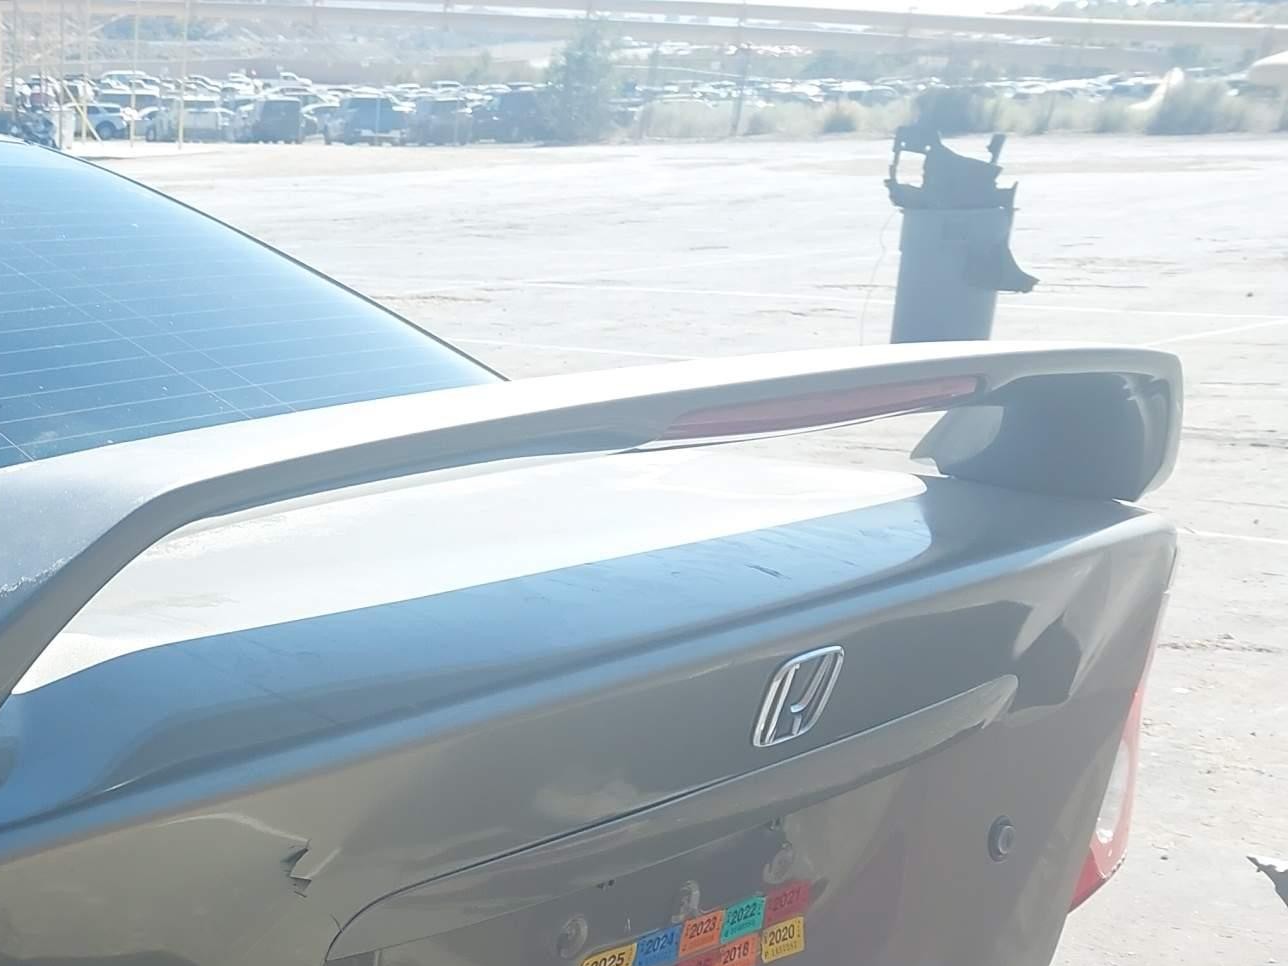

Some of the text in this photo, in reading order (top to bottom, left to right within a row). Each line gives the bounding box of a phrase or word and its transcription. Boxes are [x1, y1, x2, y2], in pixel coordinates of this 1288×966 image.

[729, 902, 758, 925] 2022
[688, 916, 717, 939] 2023
[769, 924, 795, 947] 2020
[644, 932, 675, 955] 2024
